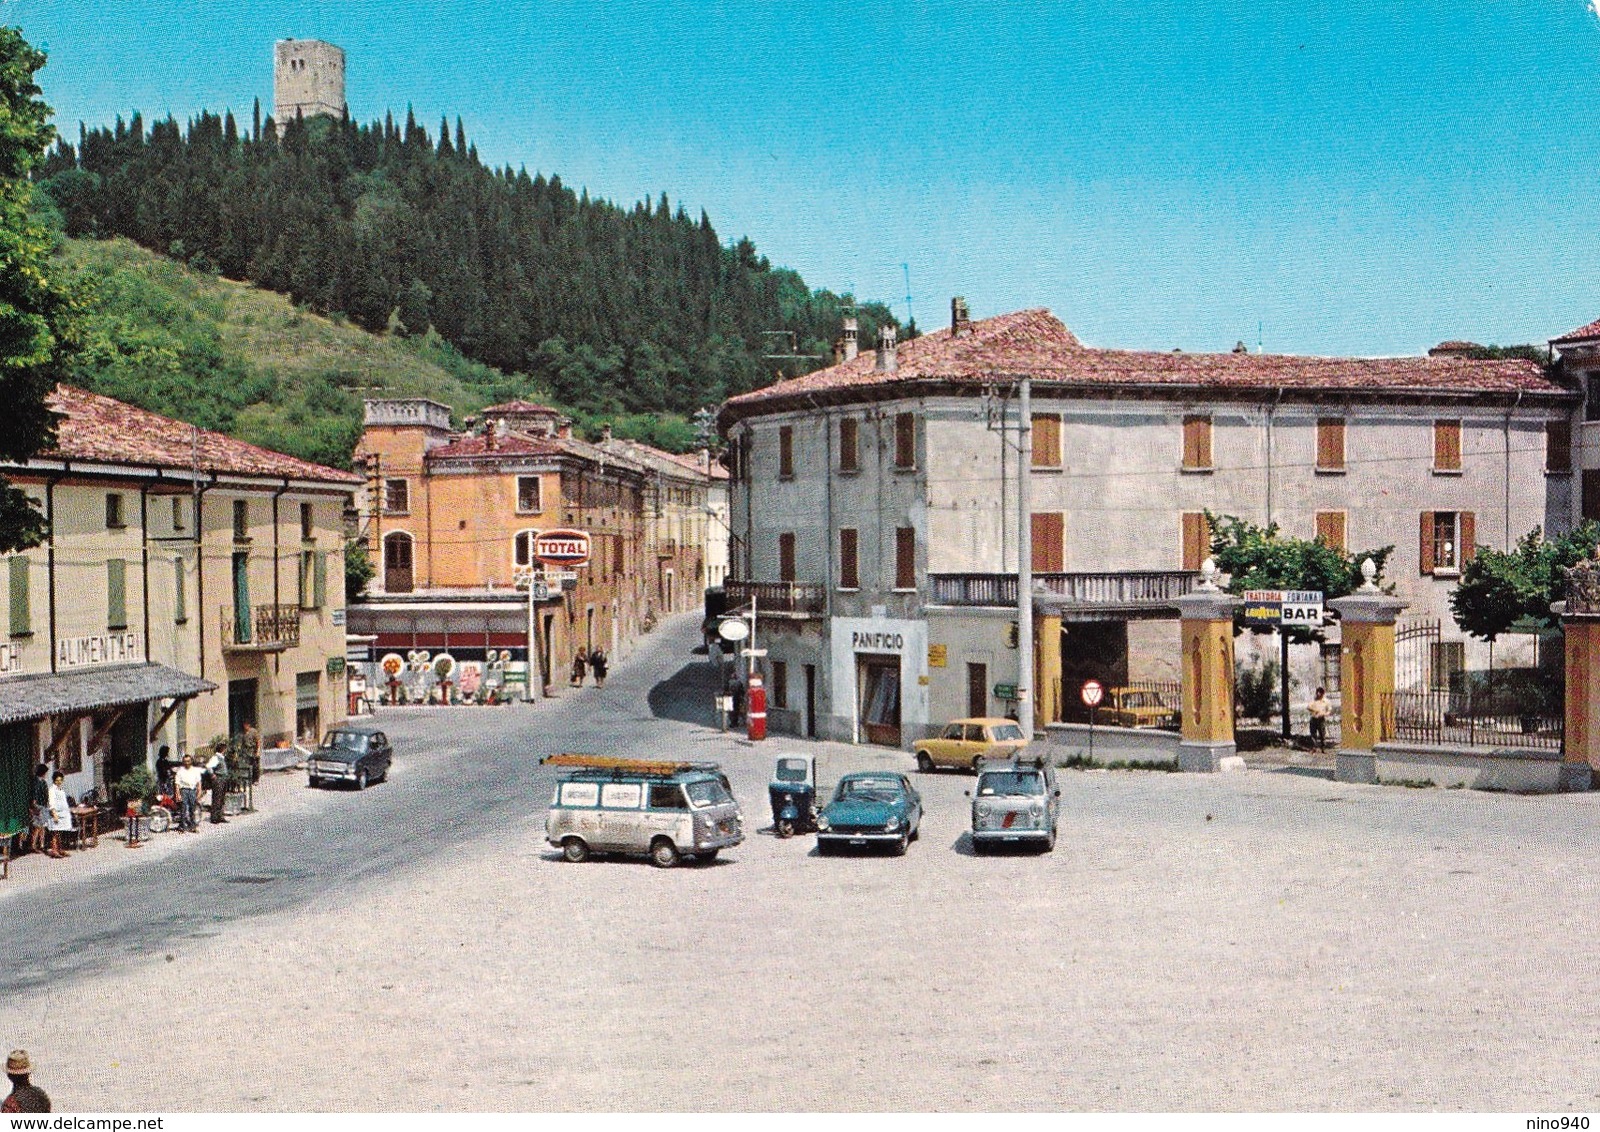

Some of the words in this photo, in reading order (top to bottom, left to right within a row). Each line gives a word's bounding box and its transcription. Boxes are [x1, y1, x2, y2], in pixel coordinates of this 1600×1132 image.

[540, 542, 585, 554] TOTAL
[1246, 592, 1282, 602] TRATTORIA
[1284, 608, 1318, 620] BAR
[852, 631, 904, 649] PANIFICIO
[60, 632, 140, 666] ALIMENTARI
